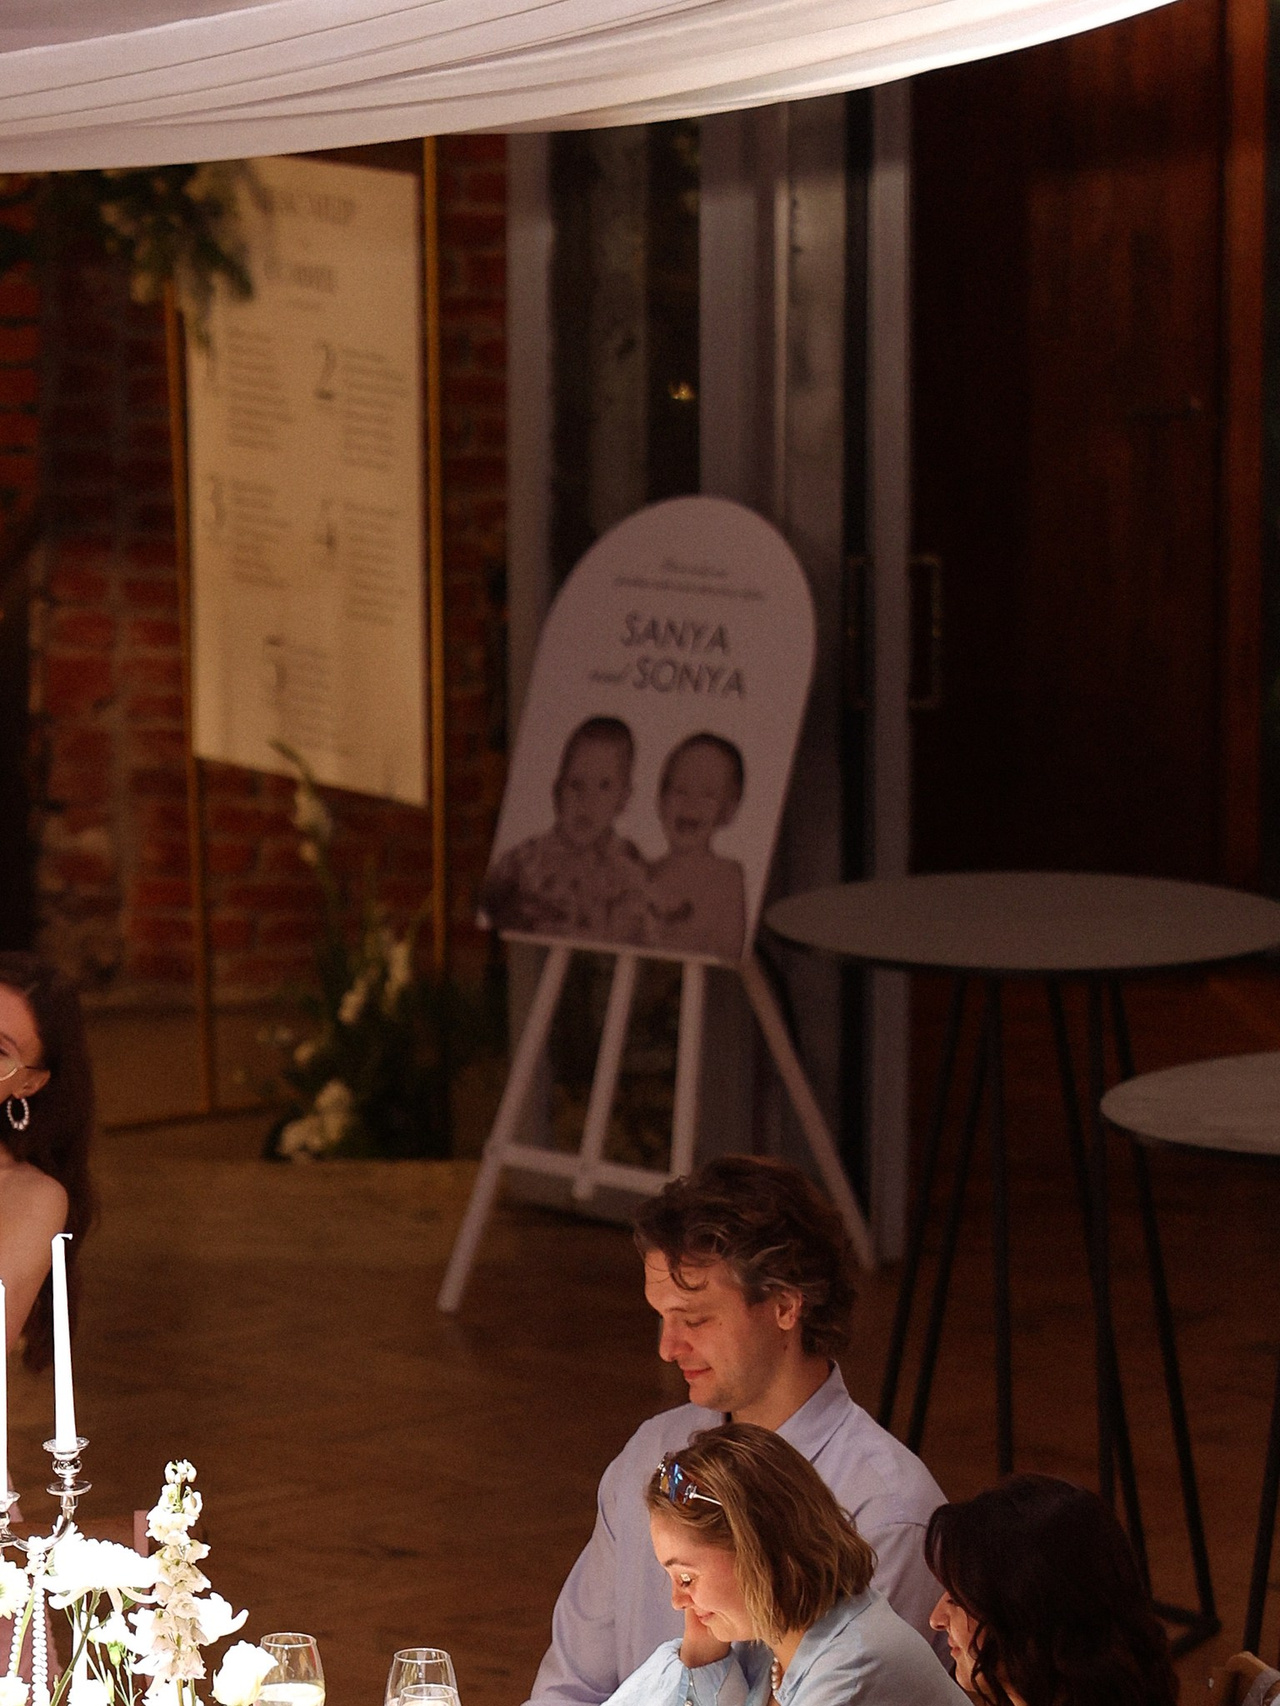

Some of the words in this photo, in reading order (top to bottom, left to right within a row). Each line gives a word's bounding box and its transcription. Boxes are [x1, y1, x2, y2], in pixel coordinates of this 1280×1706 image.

[312, 341, 336, 401] 2
[621, 611, 730, 656] SANYA
[632, 656, 745, 698] SONYA
